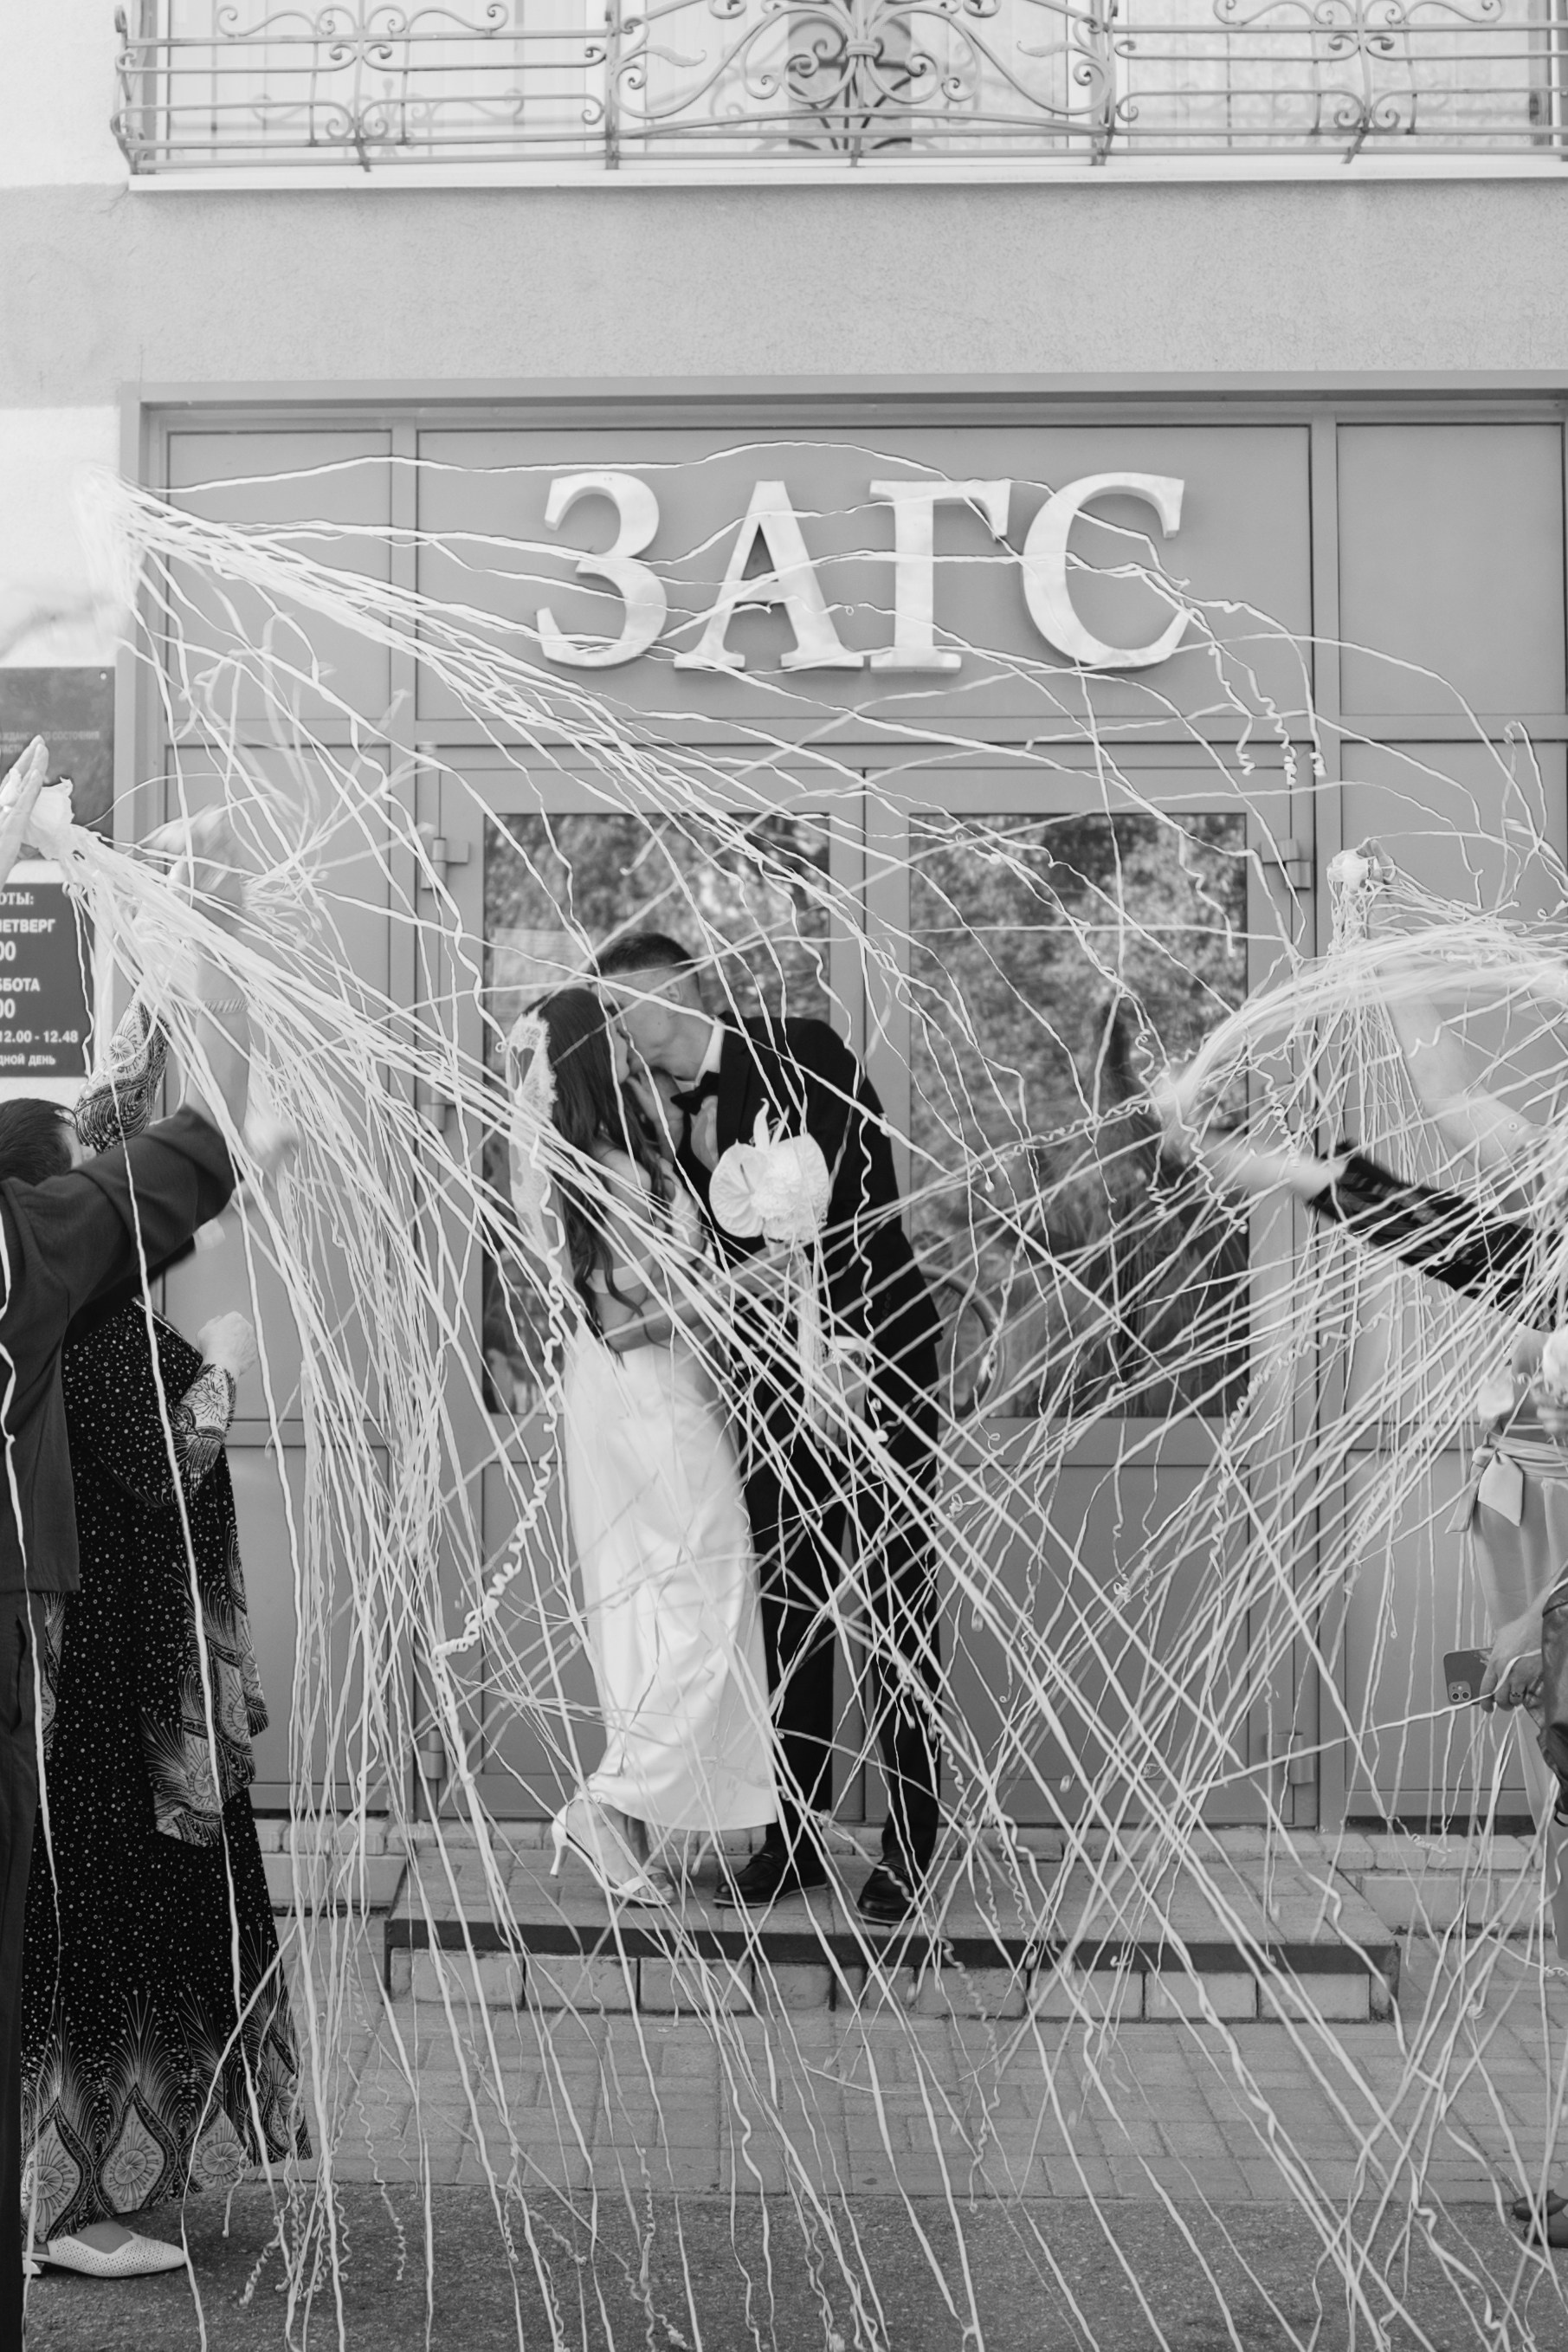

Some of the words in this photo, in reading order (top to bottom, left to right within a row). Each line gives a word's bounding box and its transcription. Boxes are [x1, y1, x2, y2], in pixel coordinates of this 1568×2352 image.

[536, 471, 1193, 674] ЗАГС
[0, 919, 55, 933] ЕТВЕРГ
[0, 978, 40, 992] БОТА
[43, 1030, 79, 1043] 12.48
[28, 1055, 56, 1066] ДЕНЬ
